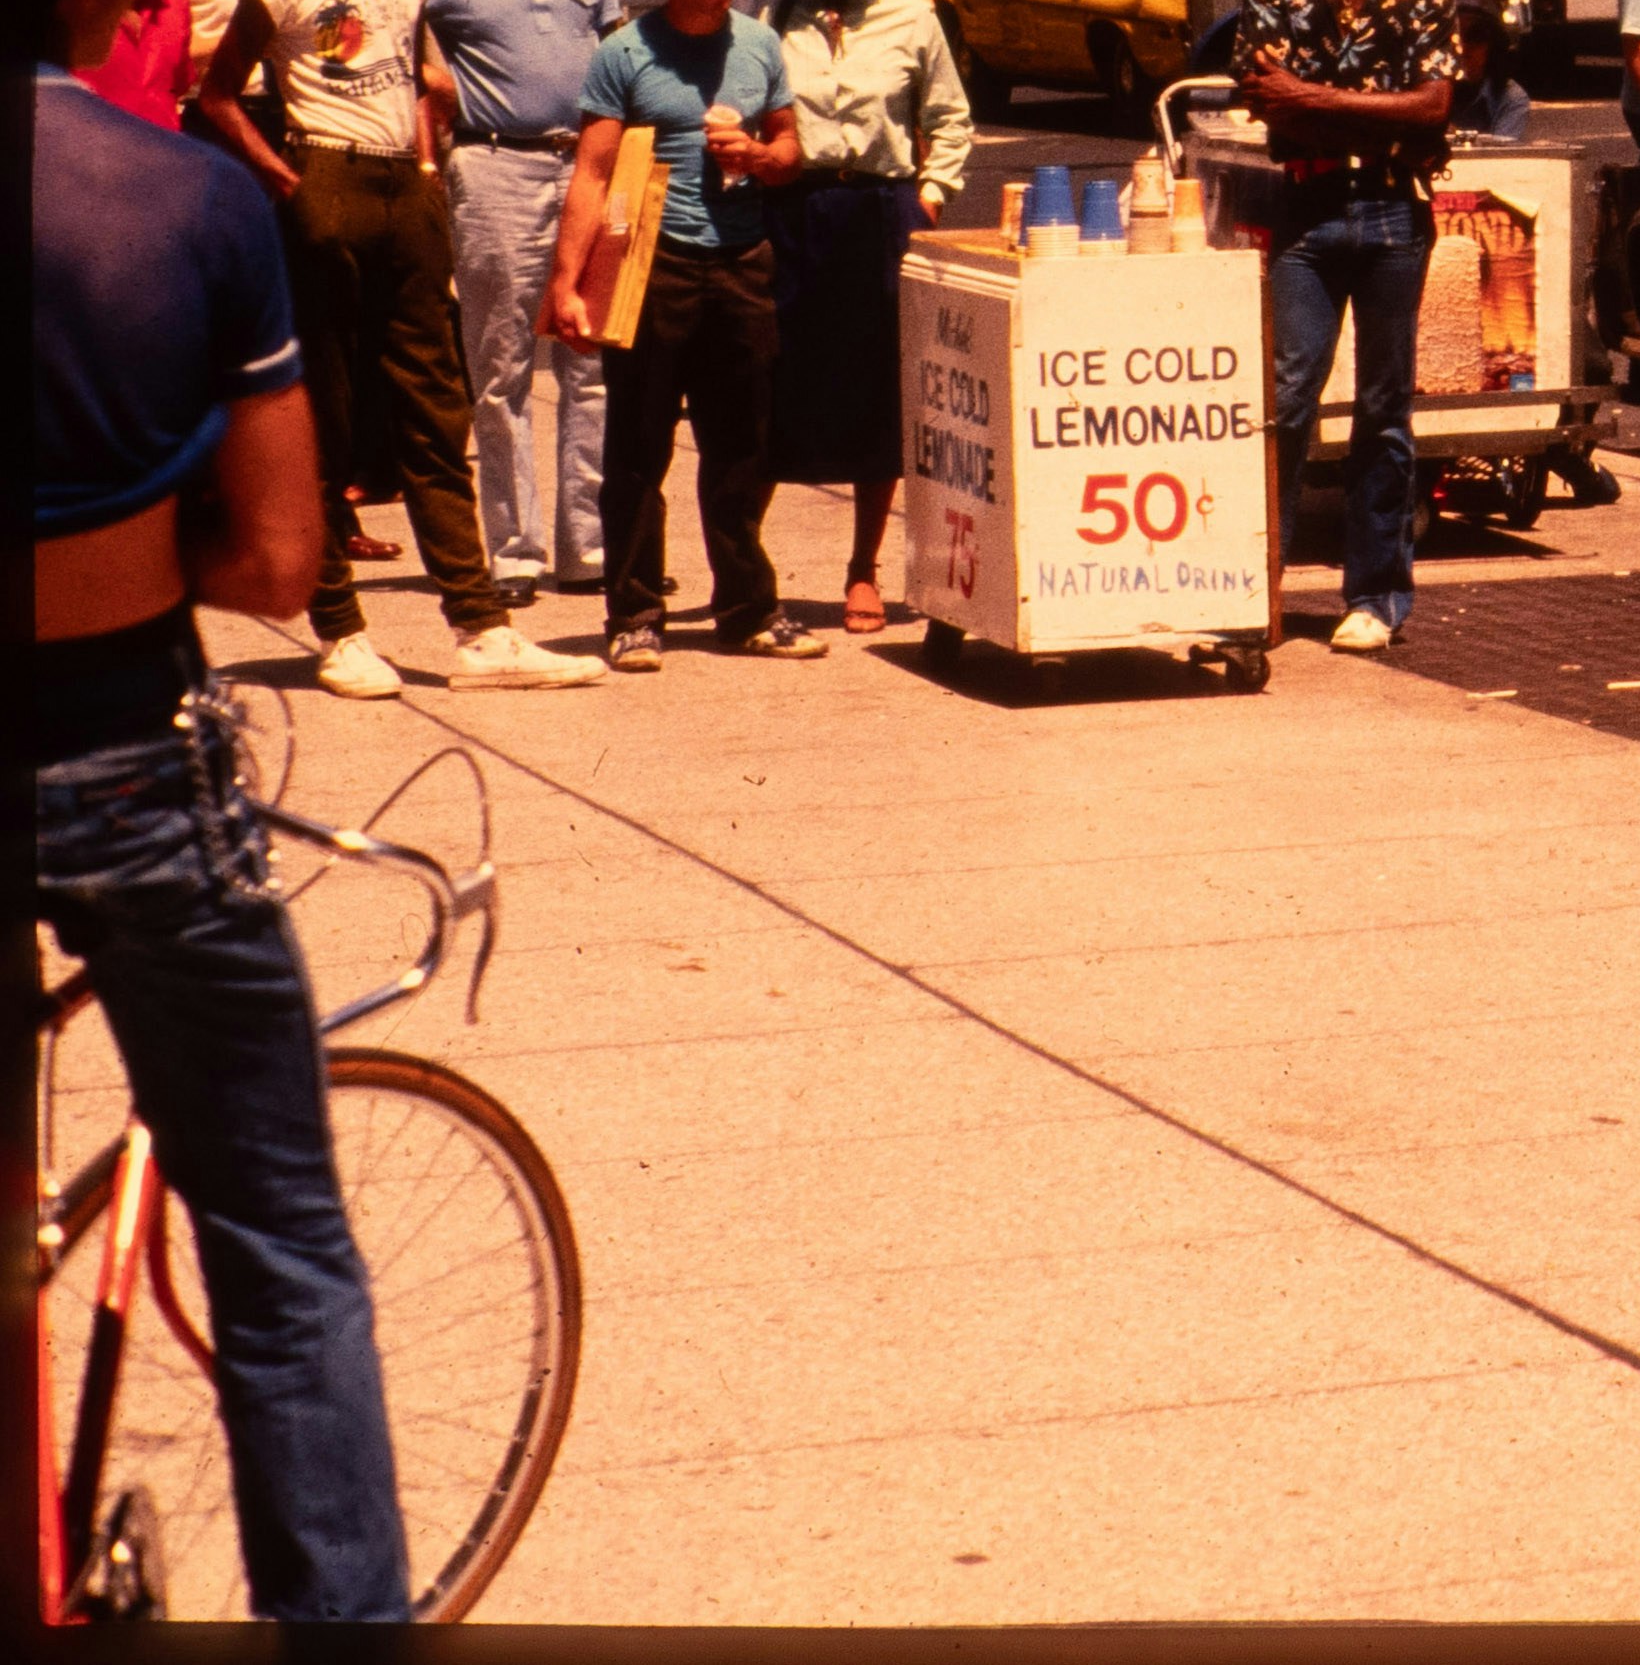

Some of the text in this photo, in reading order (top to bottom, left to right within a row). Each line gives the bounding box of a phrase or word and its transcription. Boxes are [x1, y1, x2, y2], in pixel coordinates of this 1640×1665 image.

[919, 358, 990, 427] ICE COLD
[1038, 346, 1239, 388] ICE COLD
[1030, 402, 1253, 450] LEMONADE
[913, 419, 996, 505] LEMONADE
[944, 507, 977, 600] 75
[1038, 560, 1256, 597] NATURAL DRINK
